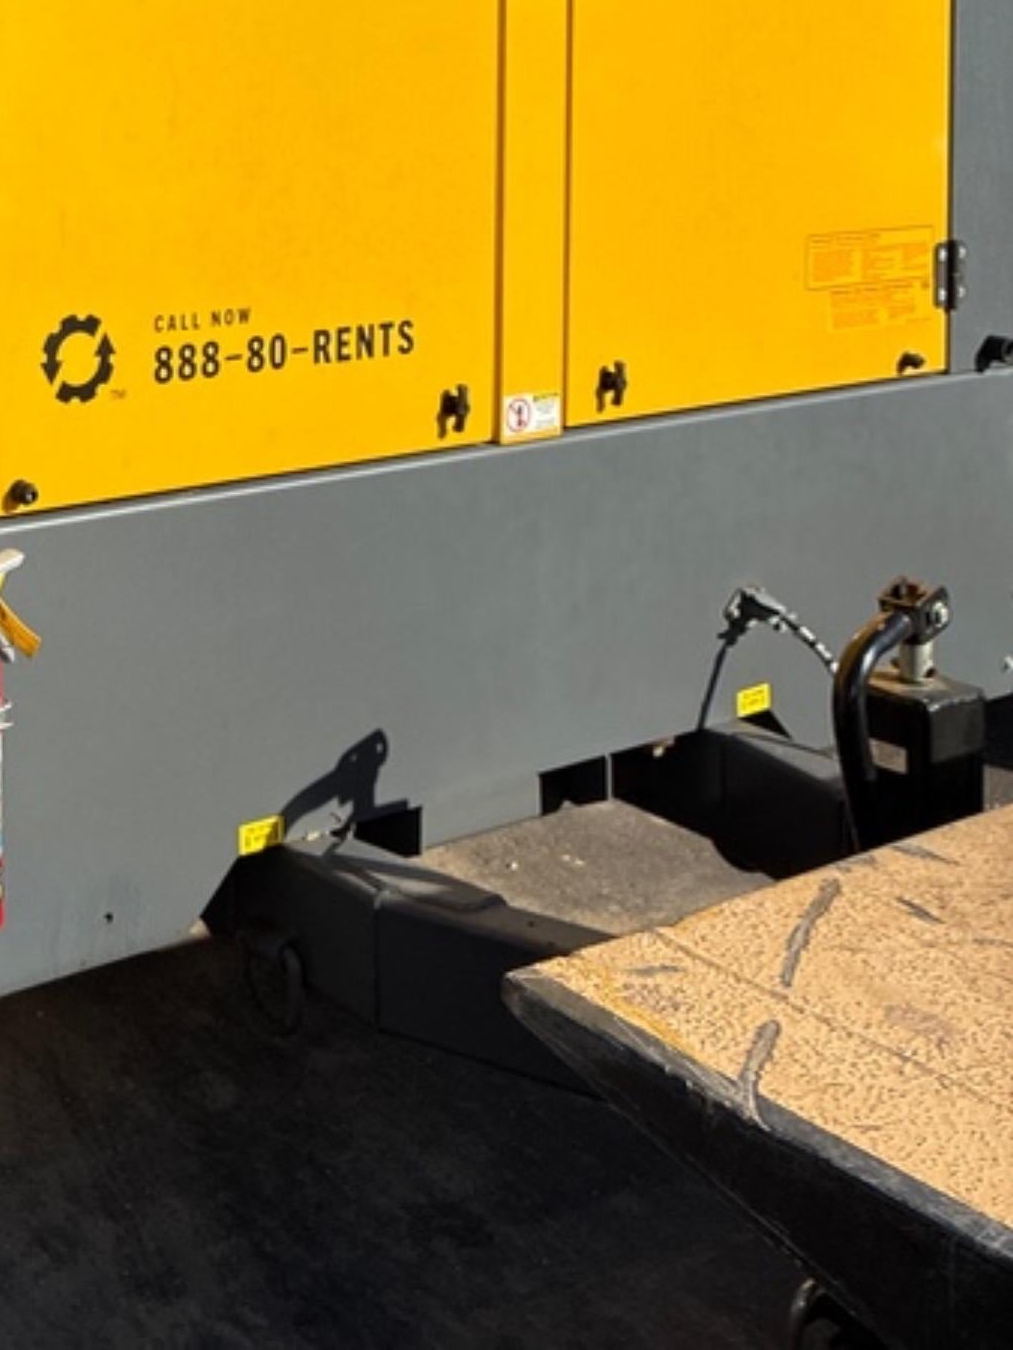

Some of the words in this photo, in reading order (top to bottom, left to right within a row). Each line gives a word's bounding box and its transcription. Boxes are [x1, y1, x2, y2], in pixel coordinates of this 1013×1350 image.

[153, 310, 201, 333] CALL
[210, 307, 252, 327] NOW
[153, 319, 415, 385] 888-80-RENTS
